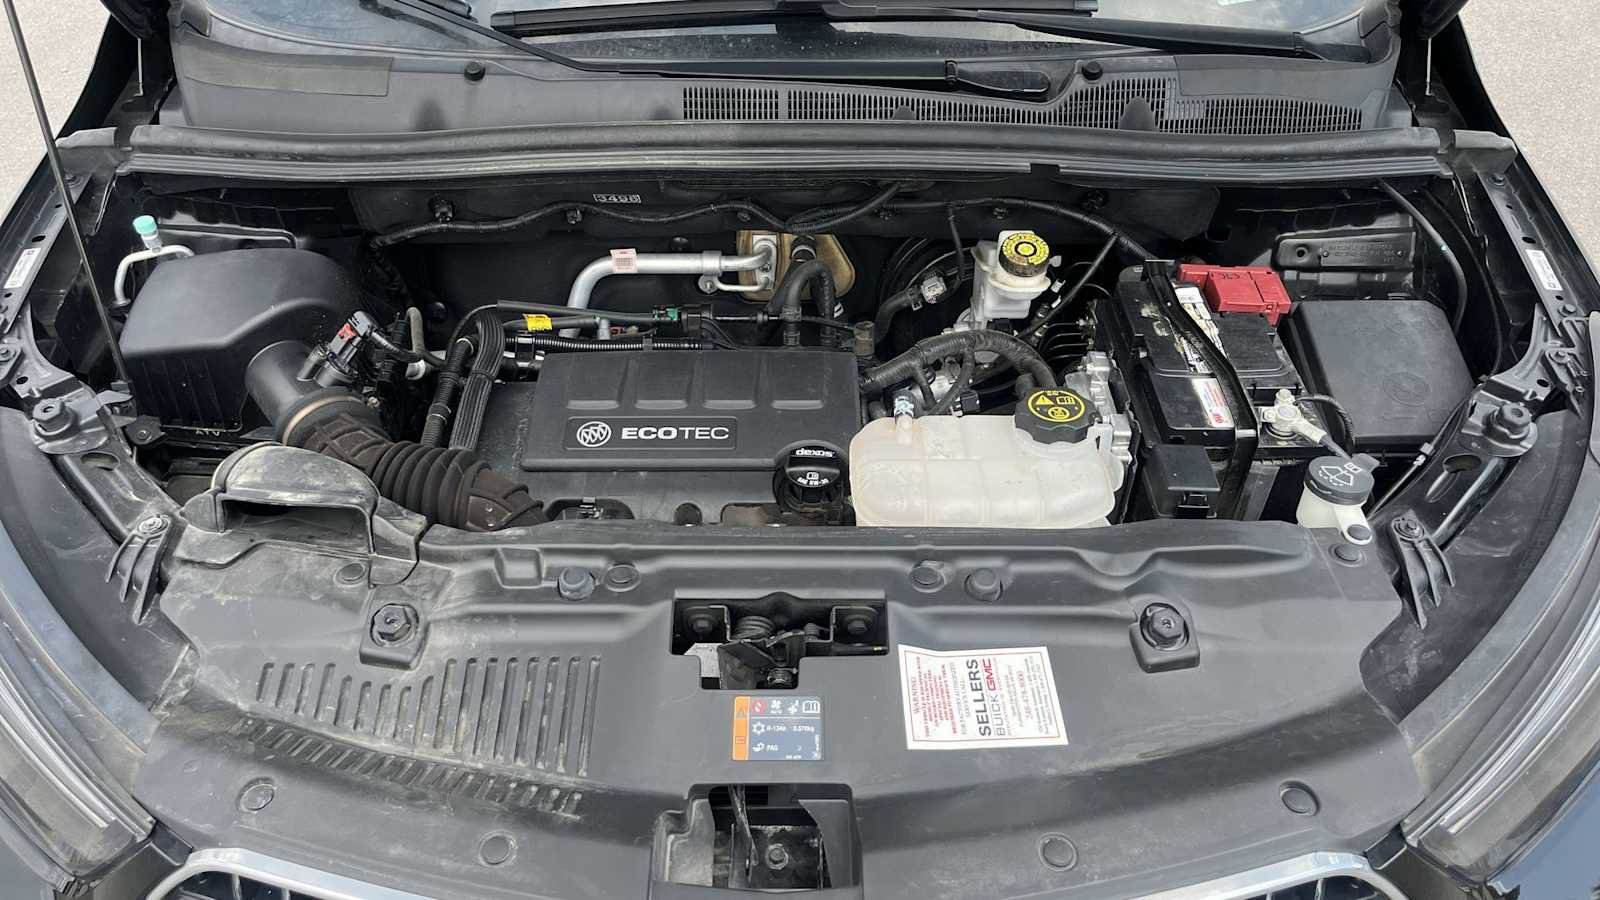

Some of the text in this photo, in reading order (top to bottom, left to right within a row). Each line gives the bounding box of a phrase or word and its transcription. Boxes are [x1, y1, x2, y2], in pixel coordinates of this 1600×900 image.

[621, 426, 729, 440] ECOTEC
[983, 658, 996, 691] GMC
[912, 676, 920, 714] WARNING
[966, 658, 992, 736] SELLERS
[991, 694, 1006, 736] BUICK
